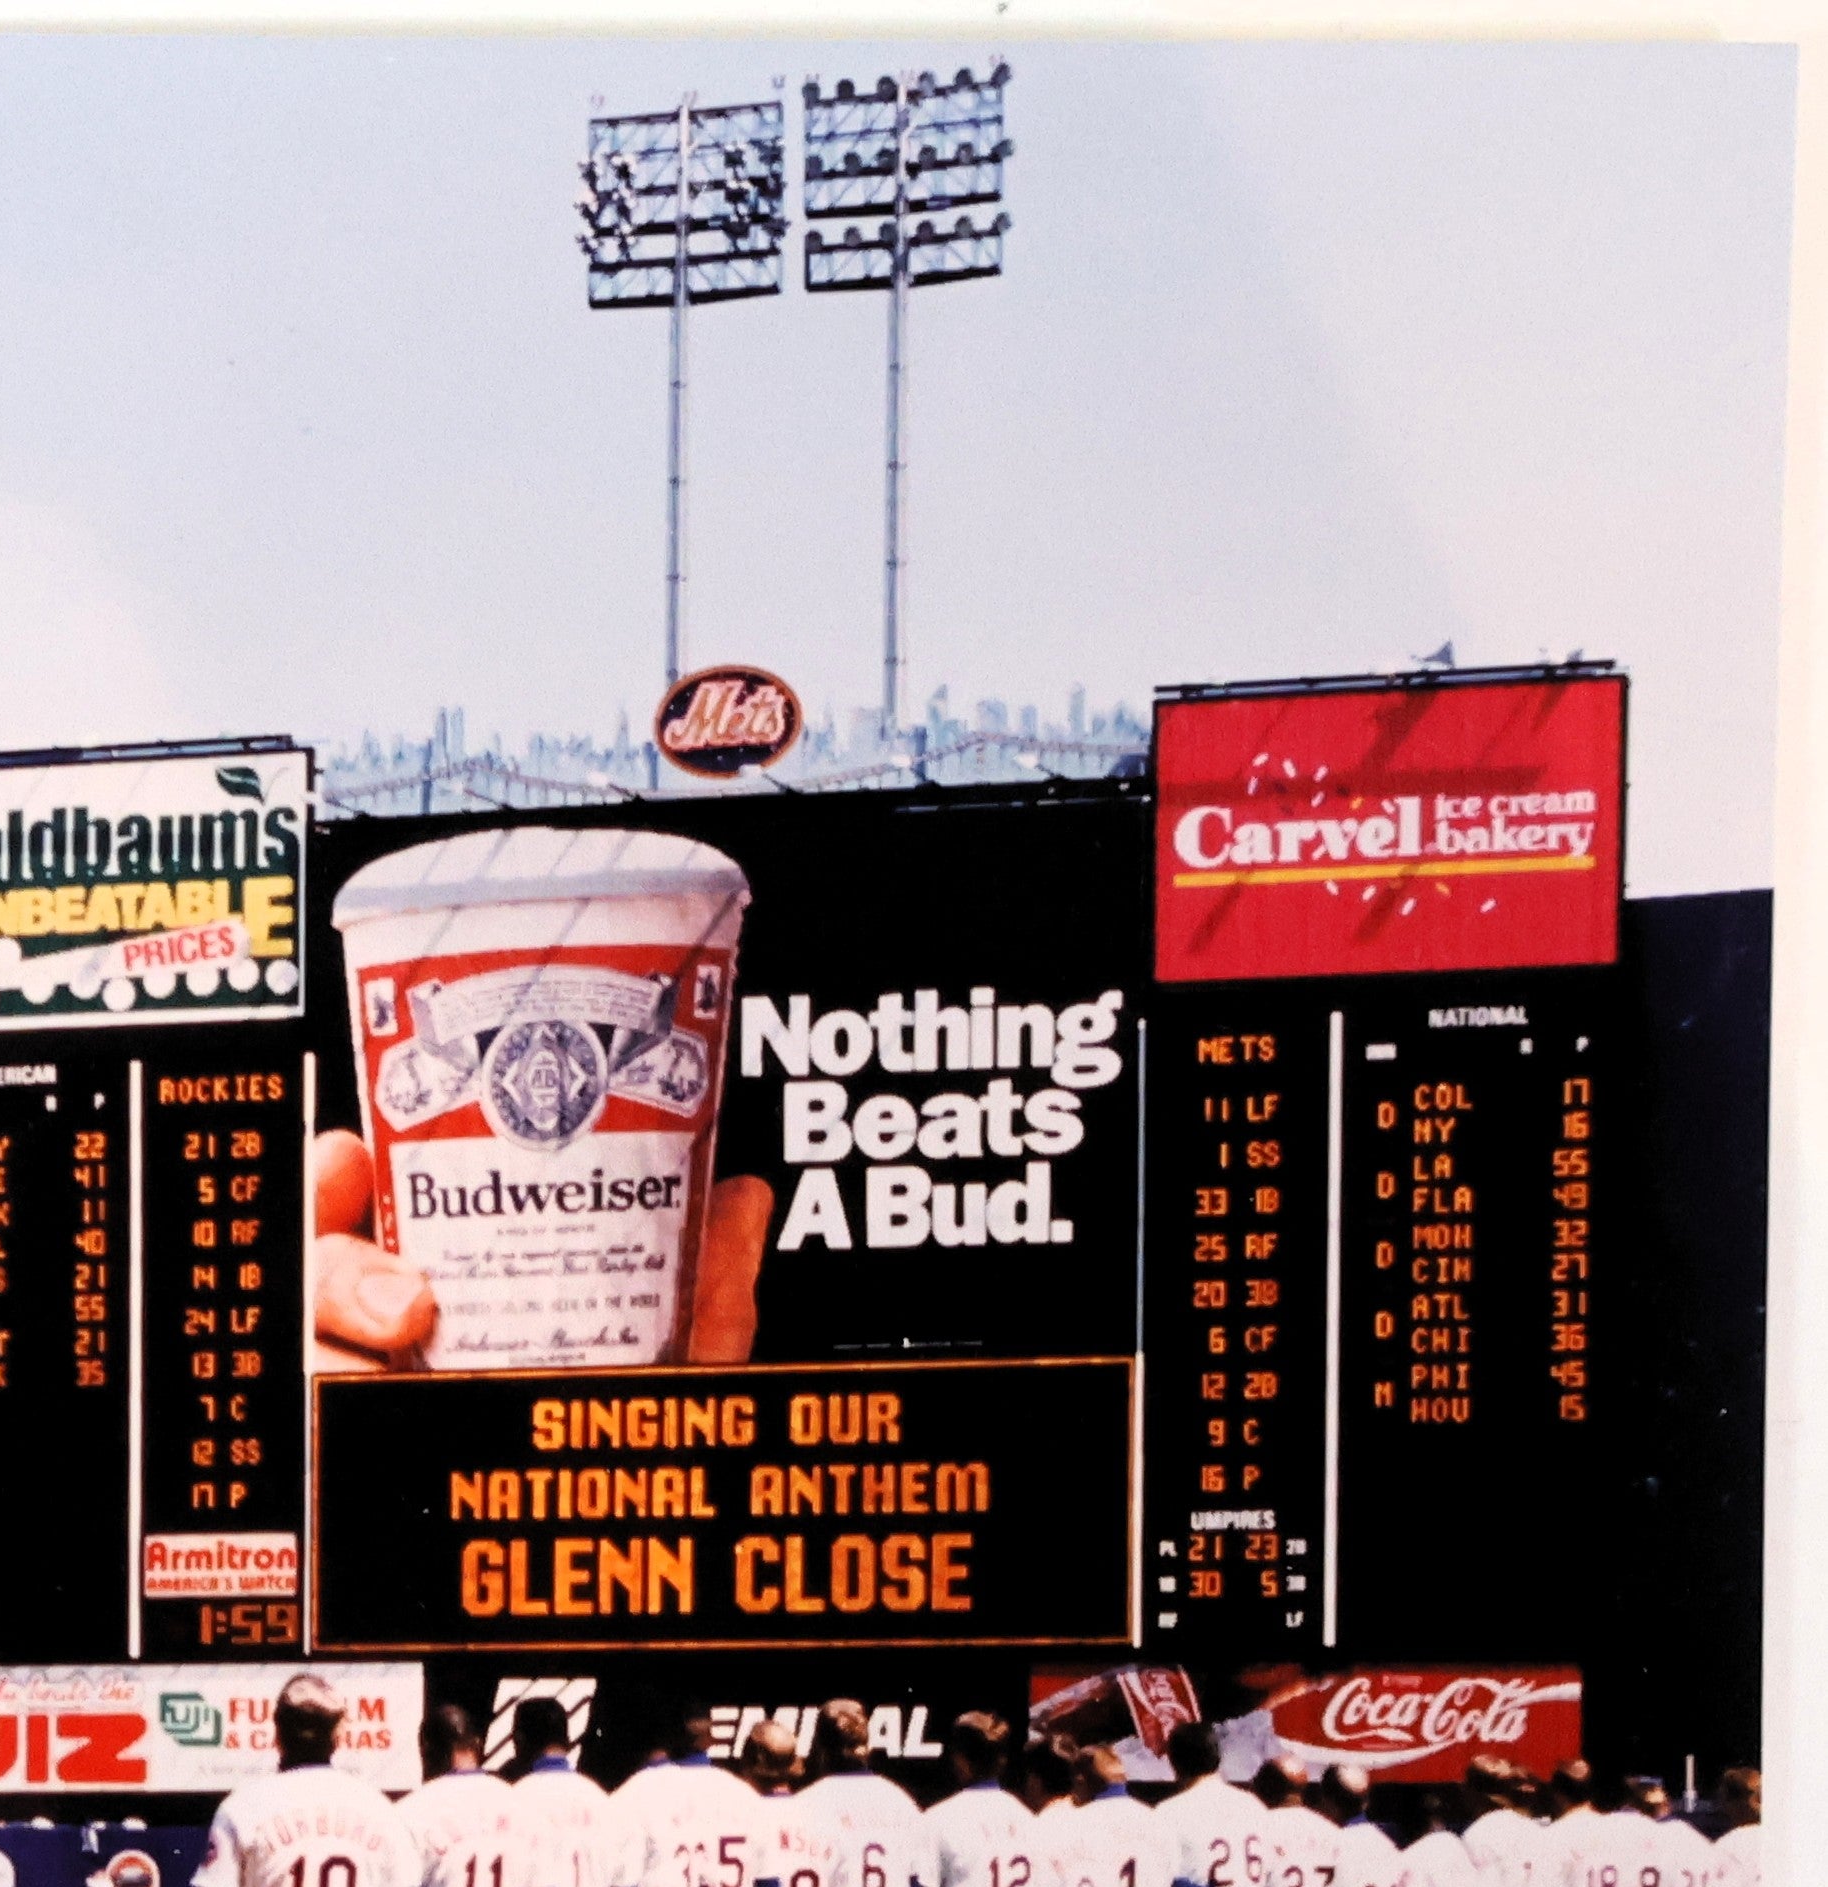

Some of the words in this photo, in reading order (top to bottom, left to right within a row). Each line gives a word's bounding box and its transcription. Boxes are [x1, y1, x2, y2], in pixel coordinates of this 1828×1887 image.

[664, 680, 785, 749] Mets
[1434, 794, 1482, 819] ice
[1487, 789, 1596, 816] cream
[1174, 796, 1424, 869] Carvel
[1434, 818, 1595, 857] bakery
[123, 927, 236, 970] PRICES
[1428, 1006, 1528, 1028] NATIONAL
[741, 988, 1125, 1089] Nothing
[1198, 1033, 1277, 1064] METS
[158, 1074, 284, 1104] ROCKIES
[1413, 1083, 1473, 1111] COL
[783, 1078, 1085, 1164] Beats
[1204, 1096, 1230, 1122] 11
[1246, 1093, 1280, 1123] LF
[73, 1131, 106, 1159] 22
[184, 1132, 215, 1160] 21
[1246, 1140, 1281, 1168] SS
[73, 1165, 106, 1188] 41
[1413, 1154, 1453, 1181] LA
[1552, 1149, 1590, 1177] 55
[198, 1177, 215, 1204] 5
[407, 1168, 681, 1219] Budweiser
[1195, 1188, 1229, 1216] 33
[1413, 1186, 1473, 1214] FLA
[82, 1199, 106, 1221] 11
[778, 1169, 851, 1252] A
[866, 1163, 1073, 1252] Bud.
[1194, 1233, 1227, 1262] 25
[74, 1264, 106, 1289] 21
[1551, 1254, 1589, 1281] 27
[1193, 1279, 1227, 1308] 20
[1412, 1294, 1469, 1320] ATL
[1552, 1290, 1588, 1317] 31
[184, 1308, 215, 1335] 24
[231, 1306, 262, 1334] LF
[74, 1329, 106, 1356] 21
[1209, 1326, 1227, 1354] 6
[1245, 1325, 1278, 1353] CF
[1411, 1327, 1472, 1354] CHI
[1411, 1363, 1470, 1389] PHI
[1550, 1360, 1587, 1388] 45
[531, 1396, 754, 1452] SINGING
[789, 1393, 901, 1445] OUR
[1411, 1397, 1470, 1423] HOU
[1208, 1419, 1226, 1447] 9
[1243, 1418, 1261, 1446] C
[449, 1469, 716, 1519] NATIONAL
[751, 1461, 990, 1516] ANTHEM
[1243, 1465, 1262, 1491] P
[229, 1481, 249, 1509] P
[147, 1541, 296, 1572] Armitron
[1188, 1535, 1223, 1562] 21
[1245, 1534, 1279, 1560] 23
[461, 1535, 693, 1616] GLENN
[735, 1533, 973, 1612] CLOSE
[1189, 1570, 1223, 1598] 30
[1261, 1569, 1279, 1598] 5
